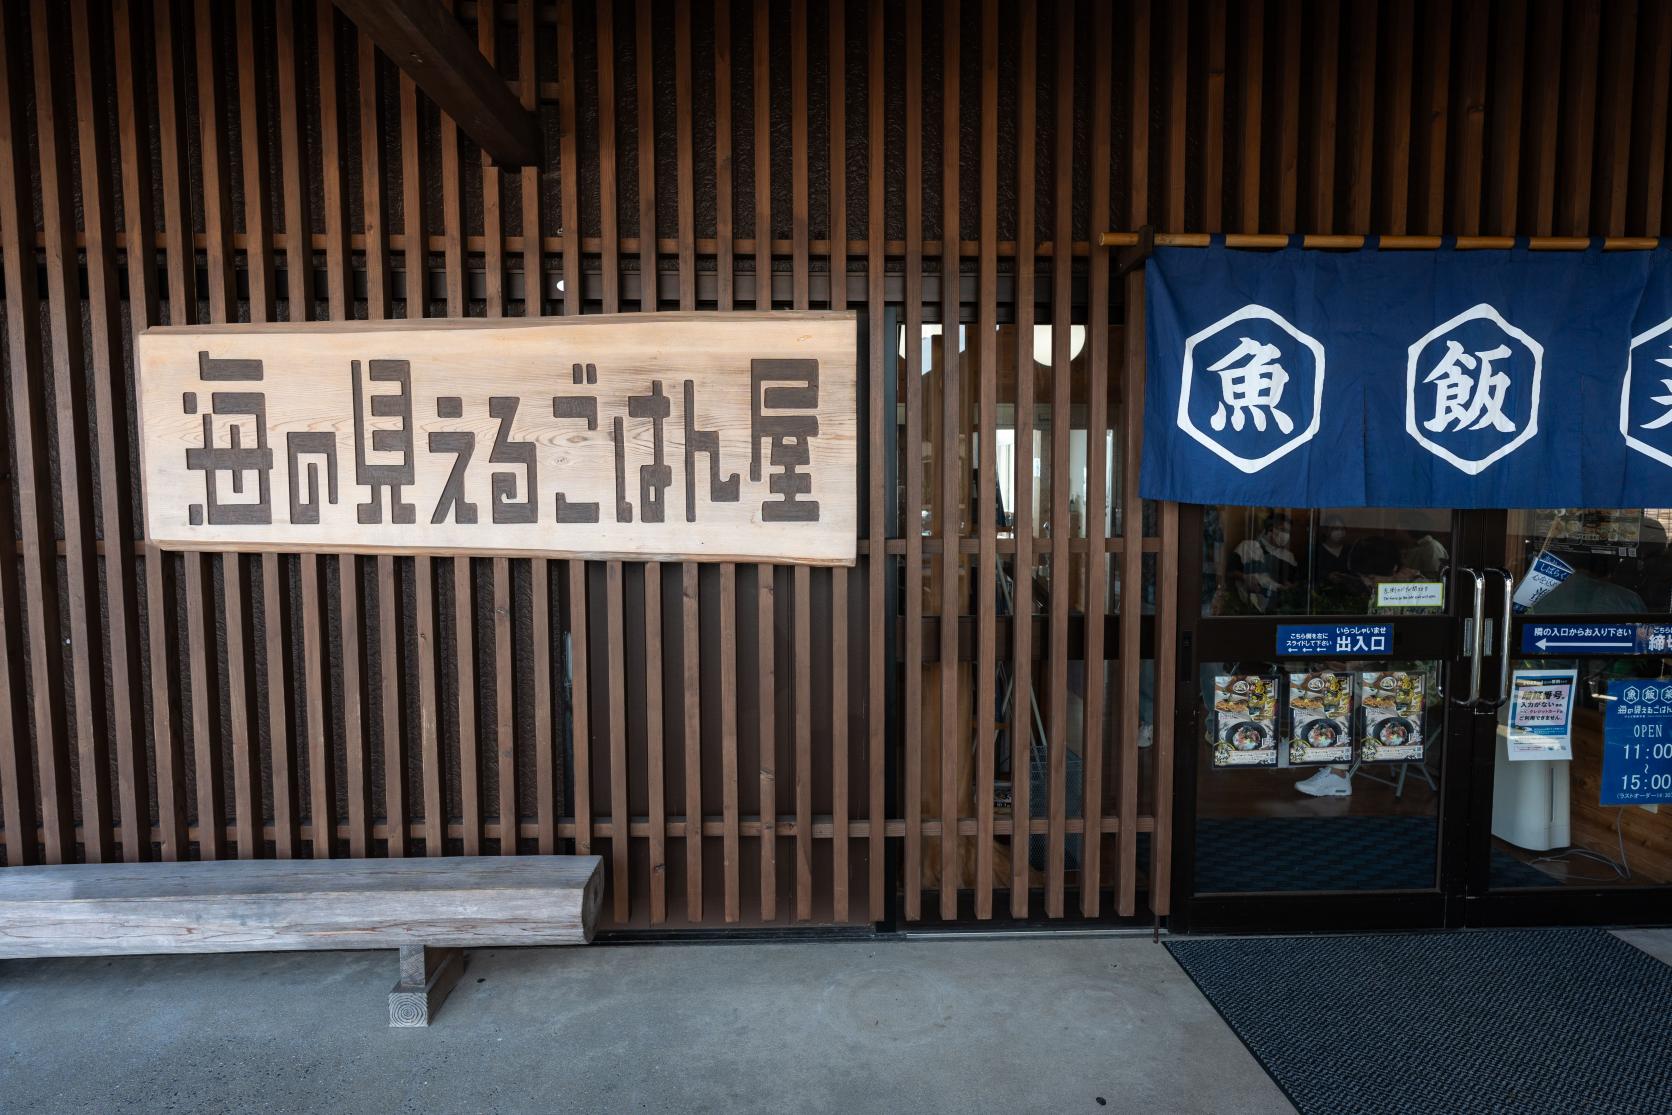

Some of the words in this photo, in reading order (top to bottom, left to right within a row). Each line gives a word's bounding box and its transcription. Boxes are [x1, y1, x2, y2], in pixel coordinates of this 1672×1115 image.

[1206, 337, 1295, 435] 魚
[1422, 339, 1517, 433] 飯
[183, 350, 819, 525] 海の見えるごはん屋
[1534, 627, 1632, 637] 隣の入口からお入り下さい
[1336, 635, 1386, 652] 出入口
[1633, 724, 1663, 738] OPEN
[1623, 743, 1672, 760] 11:00
[1621, 774, 1672, 790] 15:00
